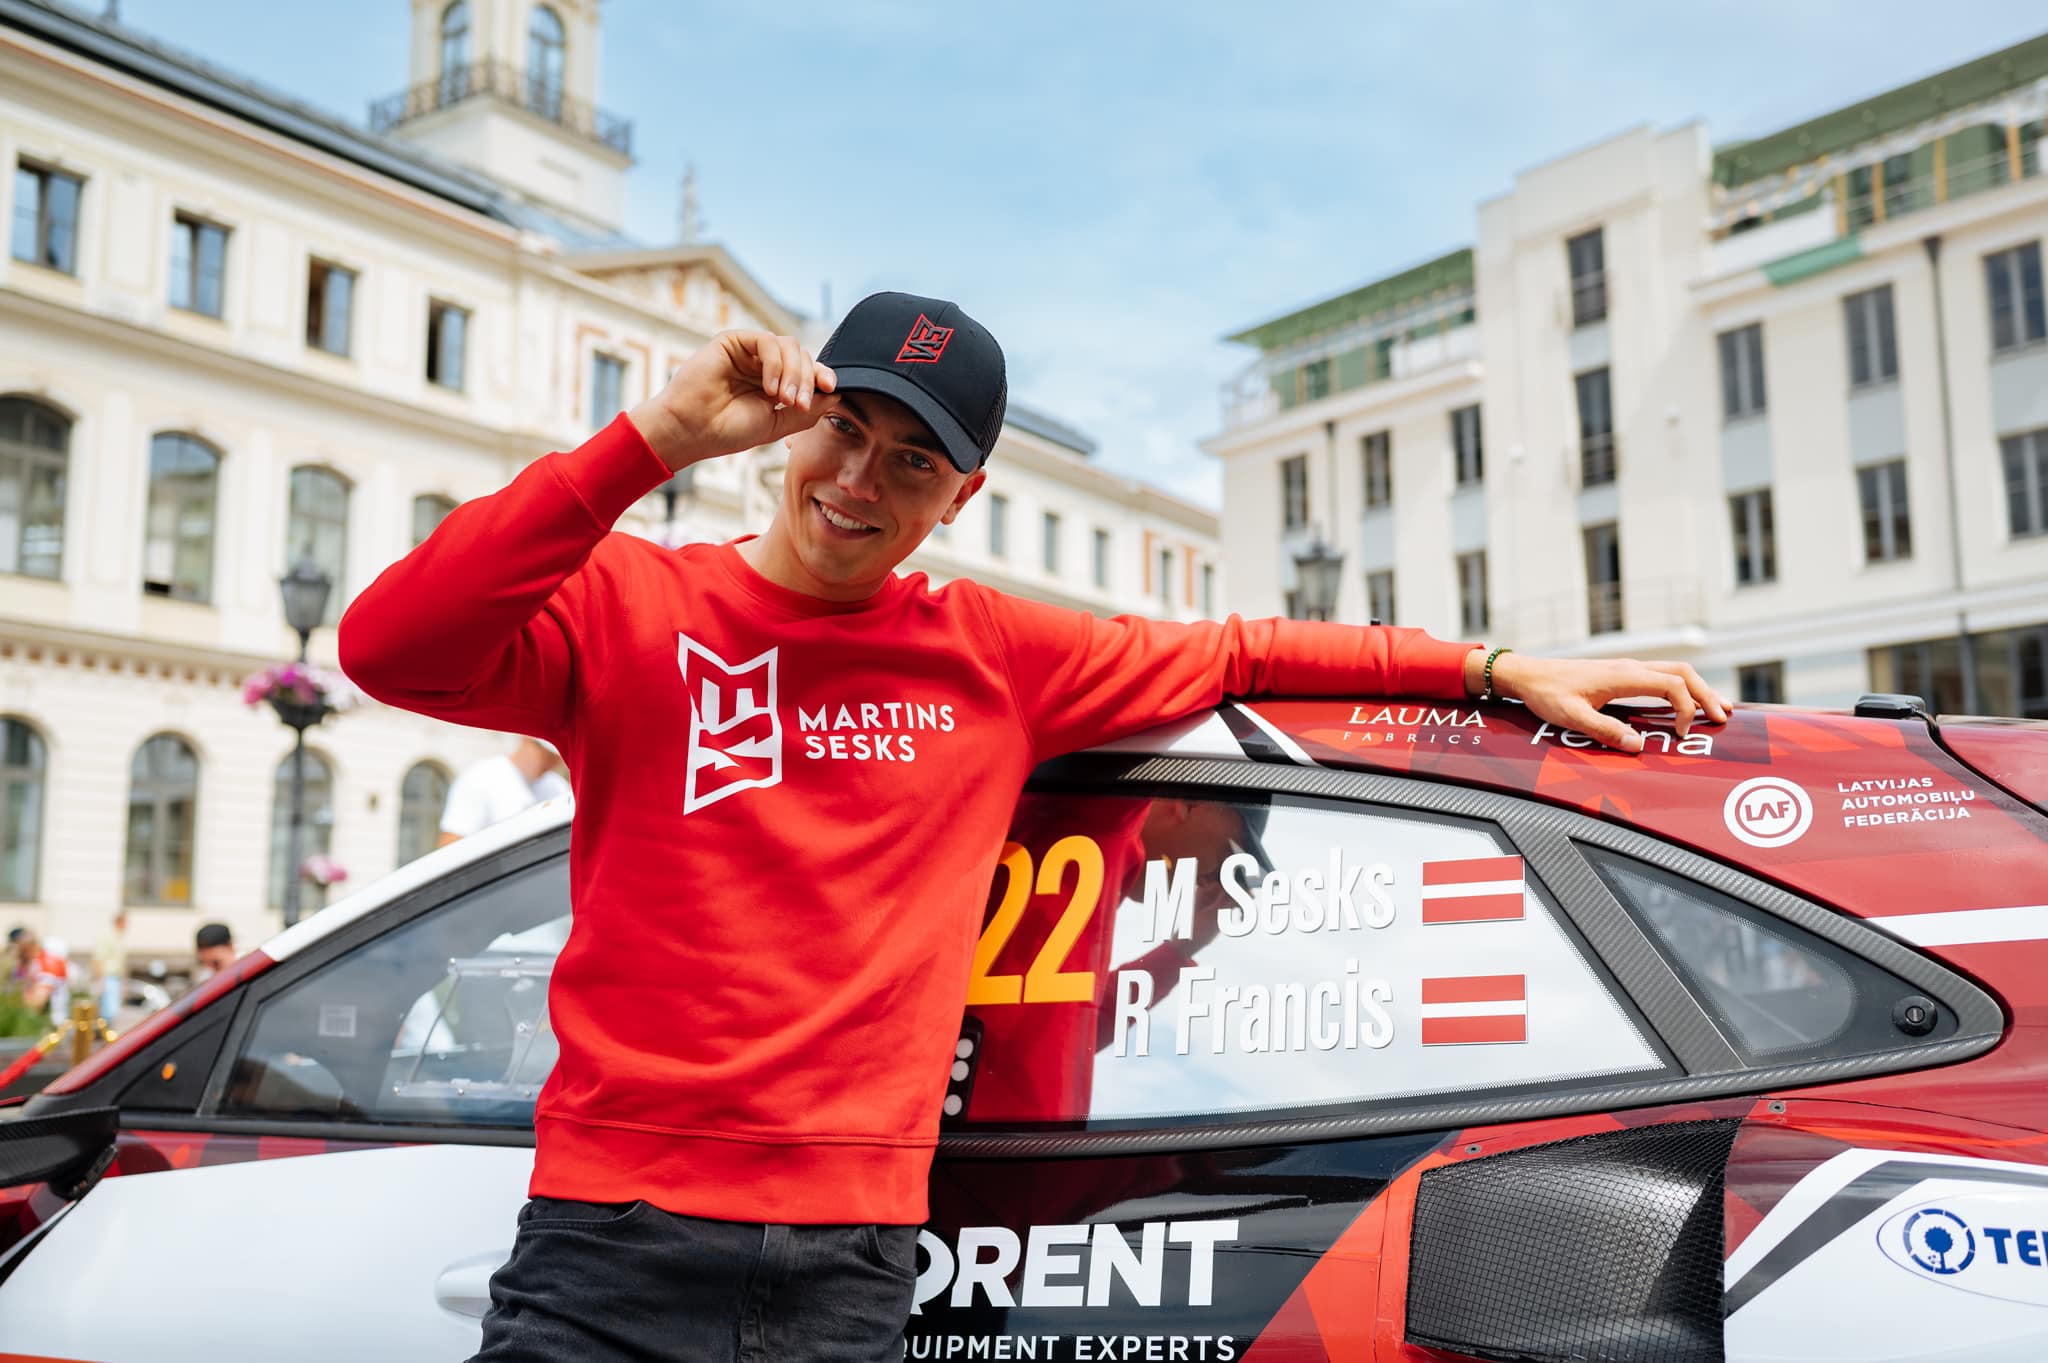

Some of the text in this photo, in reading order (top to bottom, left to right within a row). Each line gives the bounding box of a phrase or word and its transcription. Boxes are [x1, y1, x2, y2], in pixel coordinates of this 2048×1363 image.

[797, 702, 955, 732] MARTINS
[1348, 706, 1487, 728] LAUMA
[805, 734, 915, 762] SESKS
[1343, 731, 1481, 745] FABRICS
[1531, 723, 1713, 755] Fena
[1837, 777, 1934, 793] LATVIJAS
[1745, 801, 1790, 821] LAF
[1841, 790, 1975, 811] AUTOMOBIĻU
[1844, 807, 1971, 828] FEDERĀCIJA
[1142, 847, 1397, 942] M Sesks
[966, 835, 1104, 1005] 22
[1113, 958, 1394, 1057] R Francis
[1983, 1227, 2048, 1266] TE
[903, 1335, 1235, 1361] UIPMENT EXPERTS
